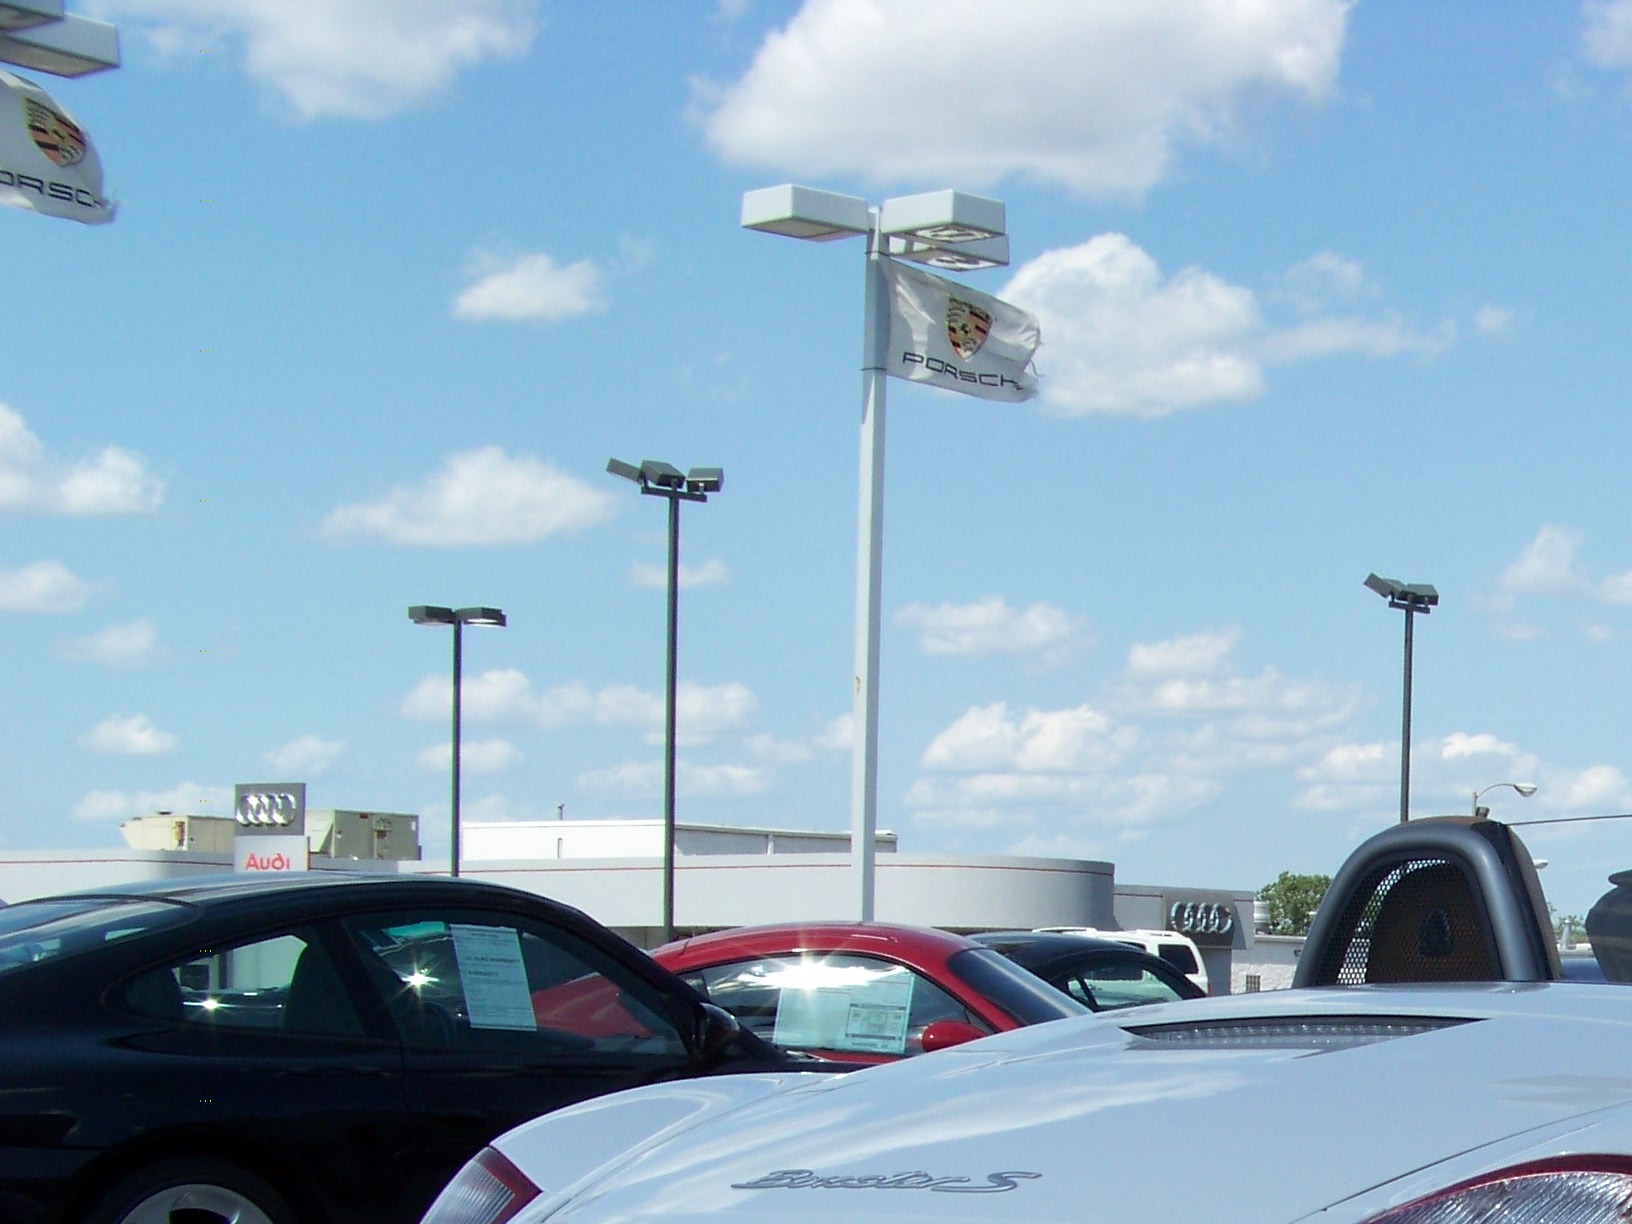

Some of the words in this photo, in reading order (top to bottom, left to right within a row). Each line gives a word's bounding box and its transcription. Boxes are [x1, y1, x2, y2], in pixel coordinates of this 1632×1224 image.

[0, 169, 104, 208] ORSC
[245, 852, 291, 871] Audi
[931, 1170, 1043, 1194] S
